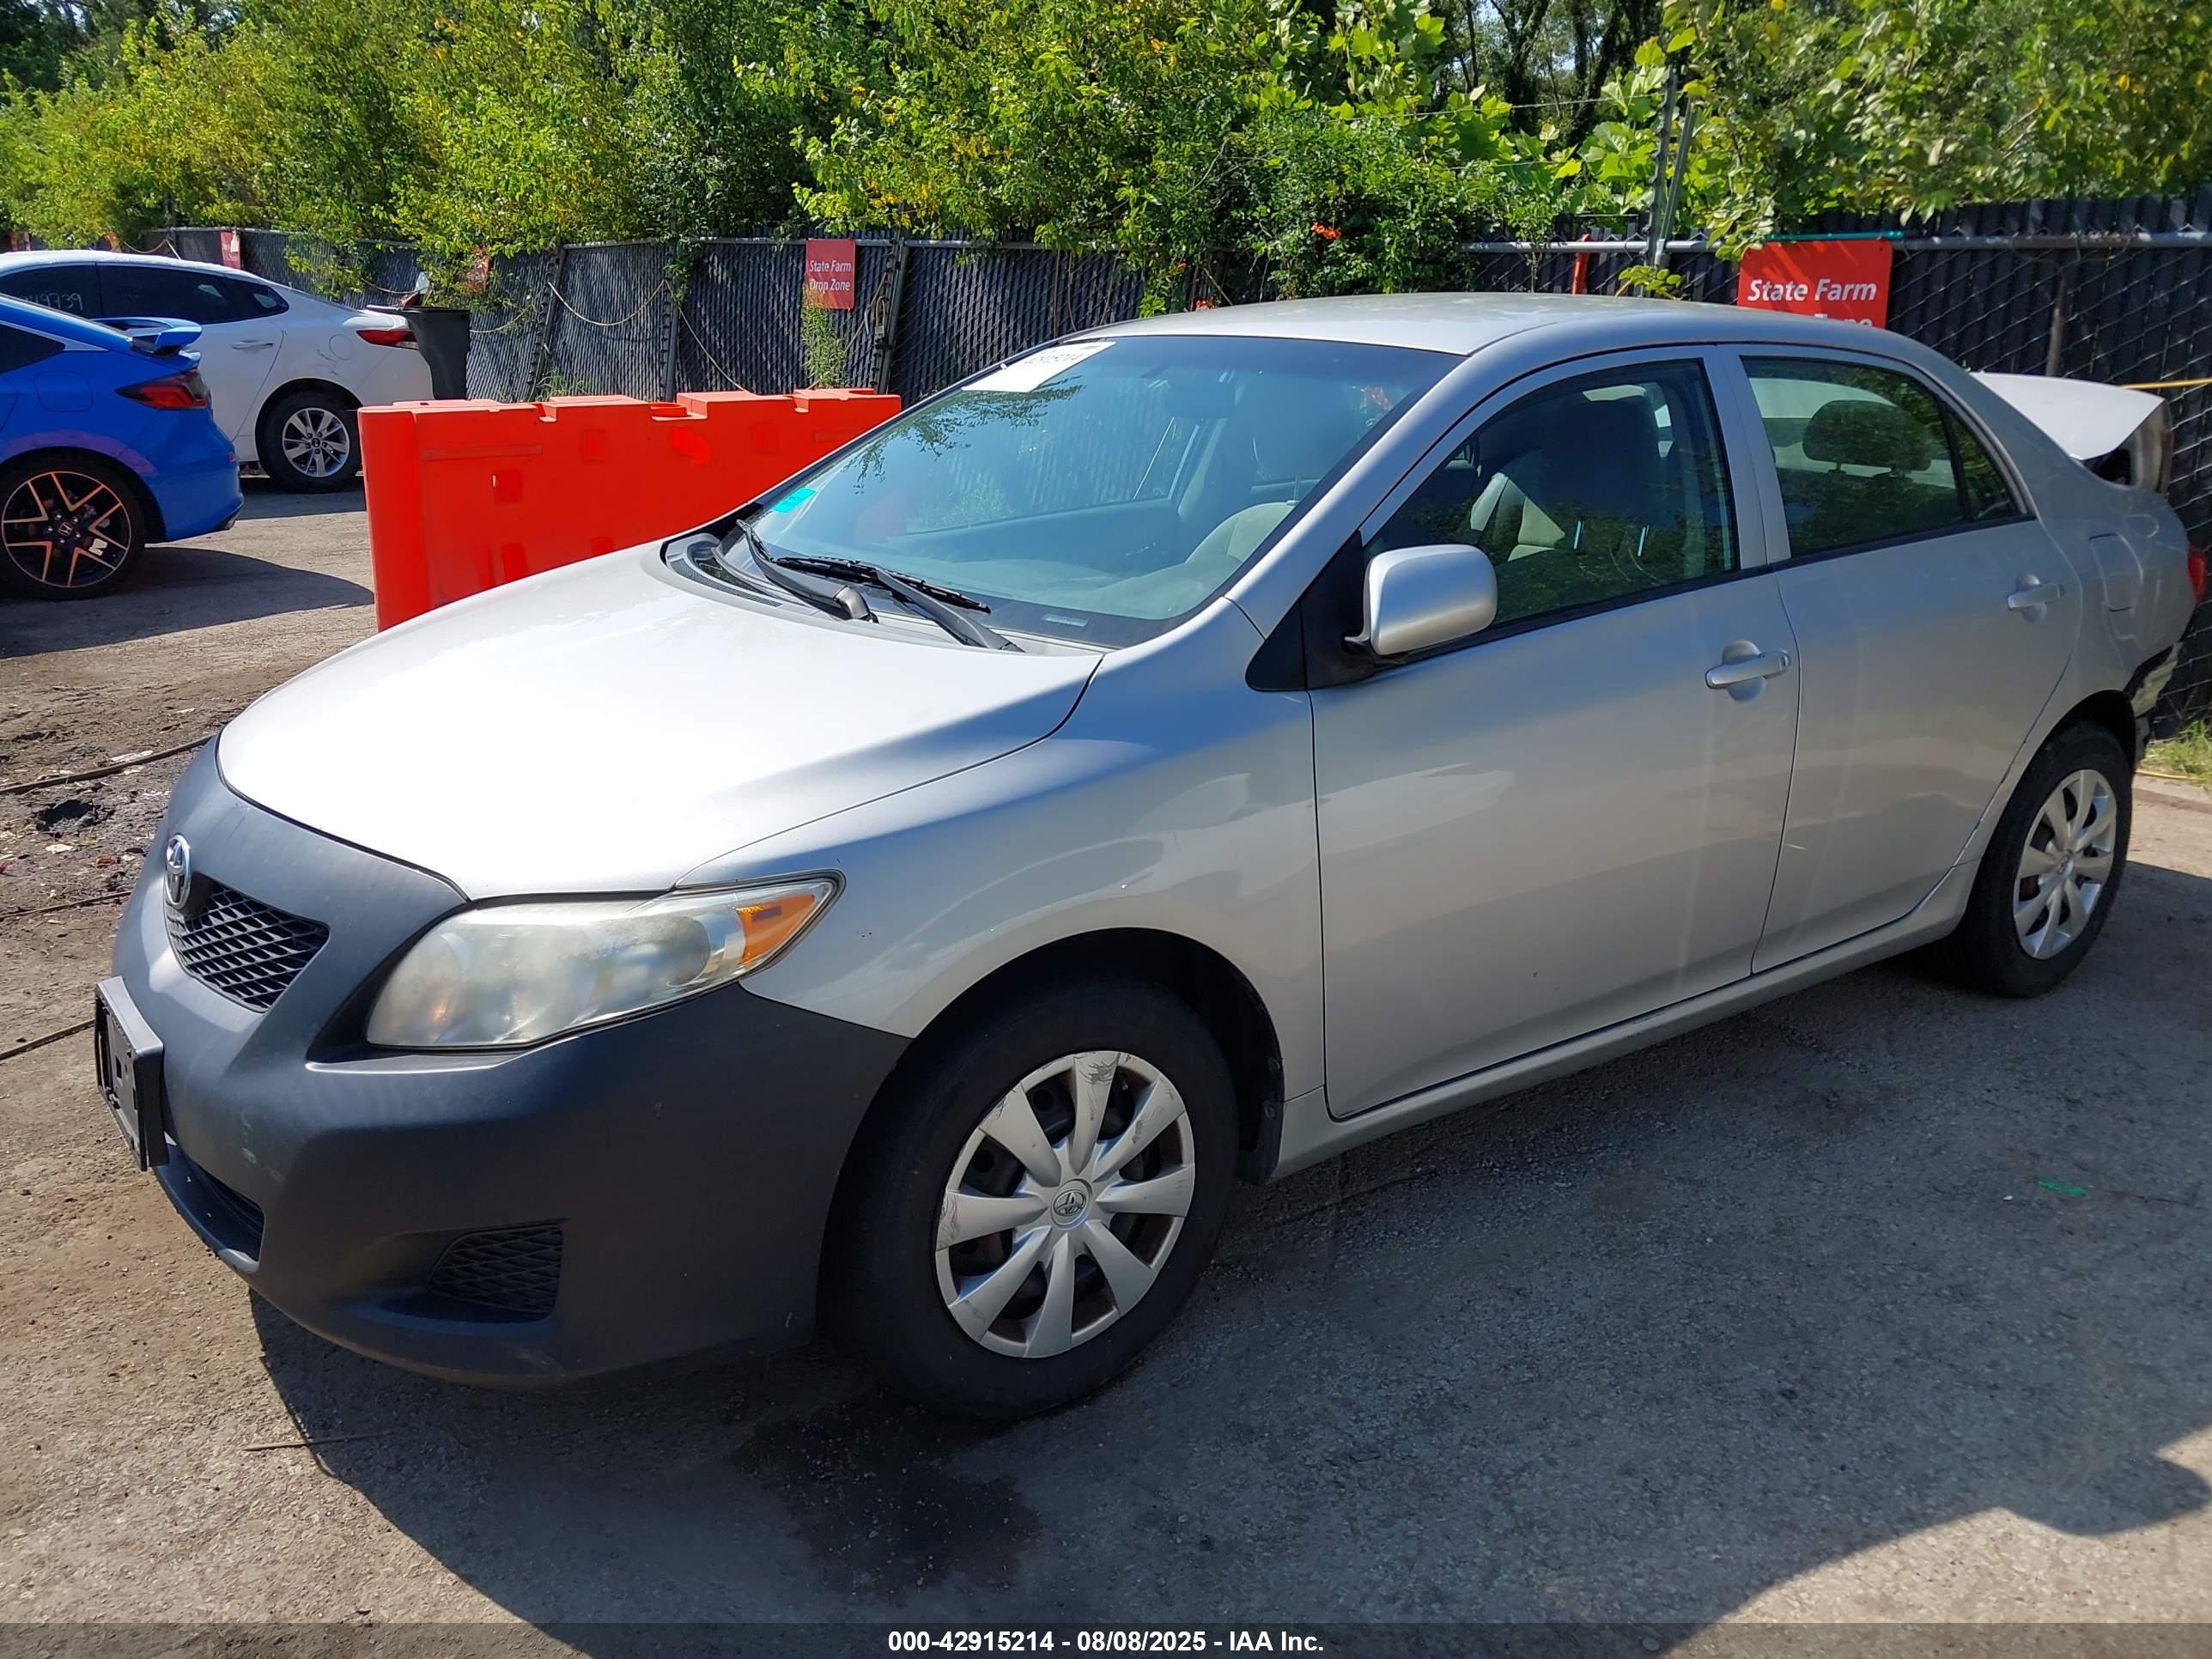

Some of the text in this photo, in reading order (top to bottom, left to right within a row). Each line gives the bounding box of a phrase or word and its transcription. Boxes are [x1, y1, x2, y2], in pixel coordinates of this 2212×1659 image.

[810, 260, 852, 272] State Farm
[810, 279, 851, 293] Drop Zone
[1747, 278, 1877, 301] State Farm
